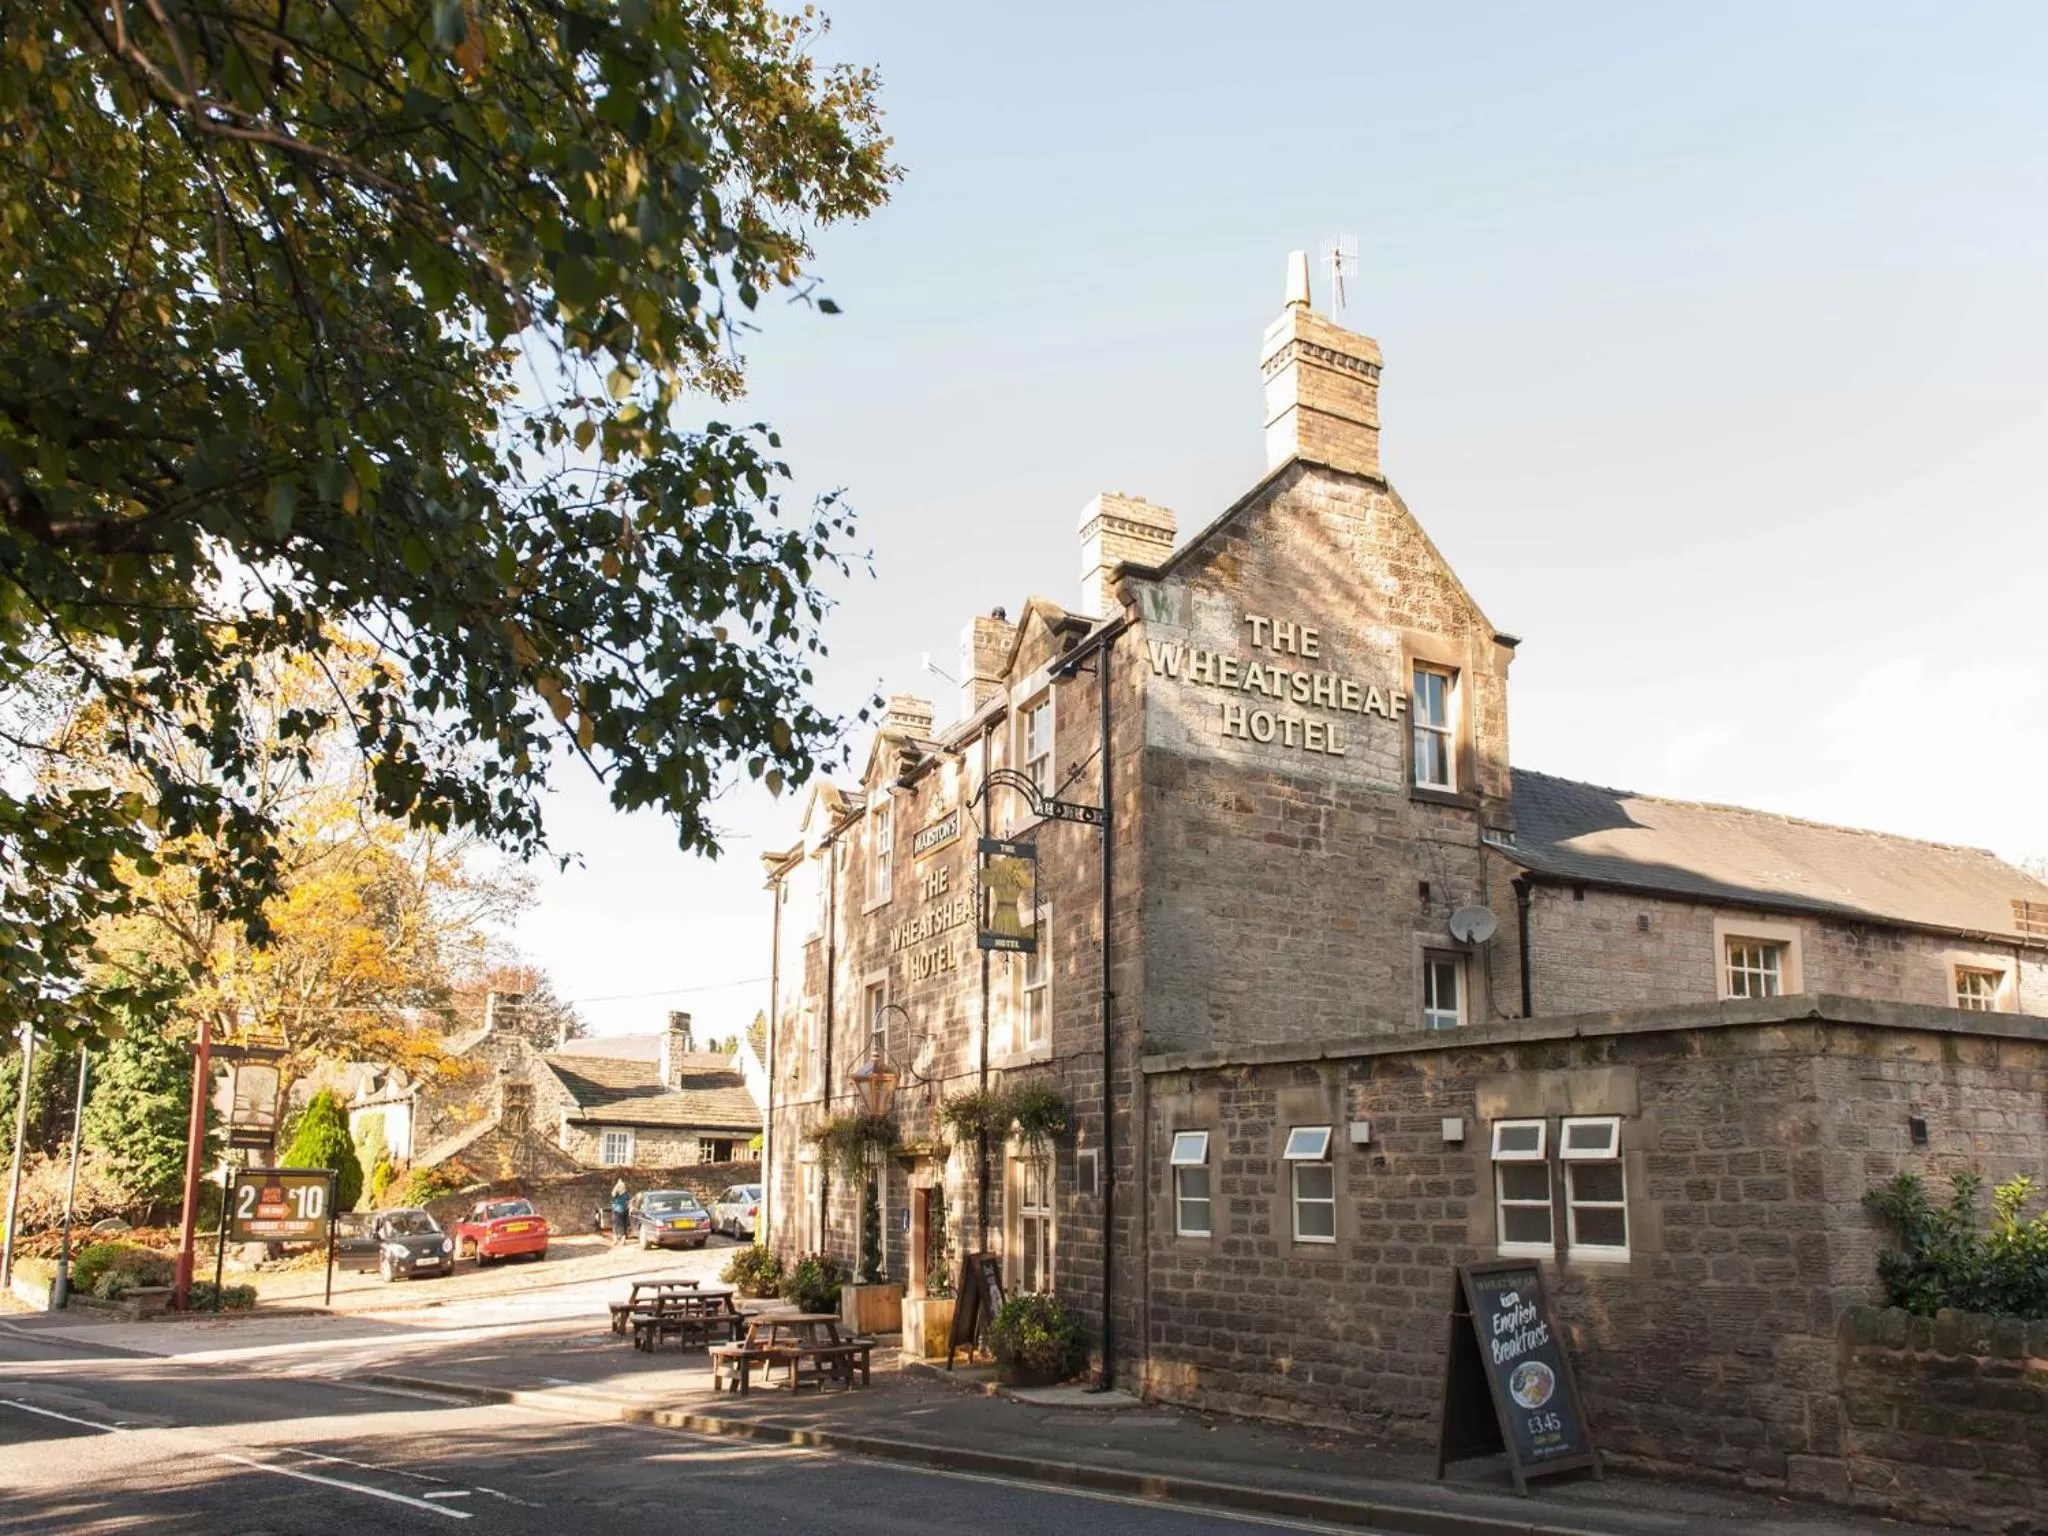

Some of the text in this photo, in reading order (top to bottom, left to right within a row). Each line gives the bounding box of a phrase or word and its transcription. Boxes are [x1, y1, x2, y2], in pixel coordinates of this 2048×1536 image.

[1244, 613, 1320, 659] THE
[1147, 639, 1407, 720] WHEATSHEAF
[1222, 702, 1345, 756] HOTEL
[921, 865, 950, 902] THE
[890, 889, 976, 953] WHEATSHEA
[912, 941, 957, 982] HOTEL
[237, 1185, 255, 1219] 2
[288, 1185, 323, 1219] £10
[1492, 1300, 1537, 1335] English
[1491, 1320, 1549, 1365] Breakfast
[1527, 1412, 1561, 1434] £3.45
